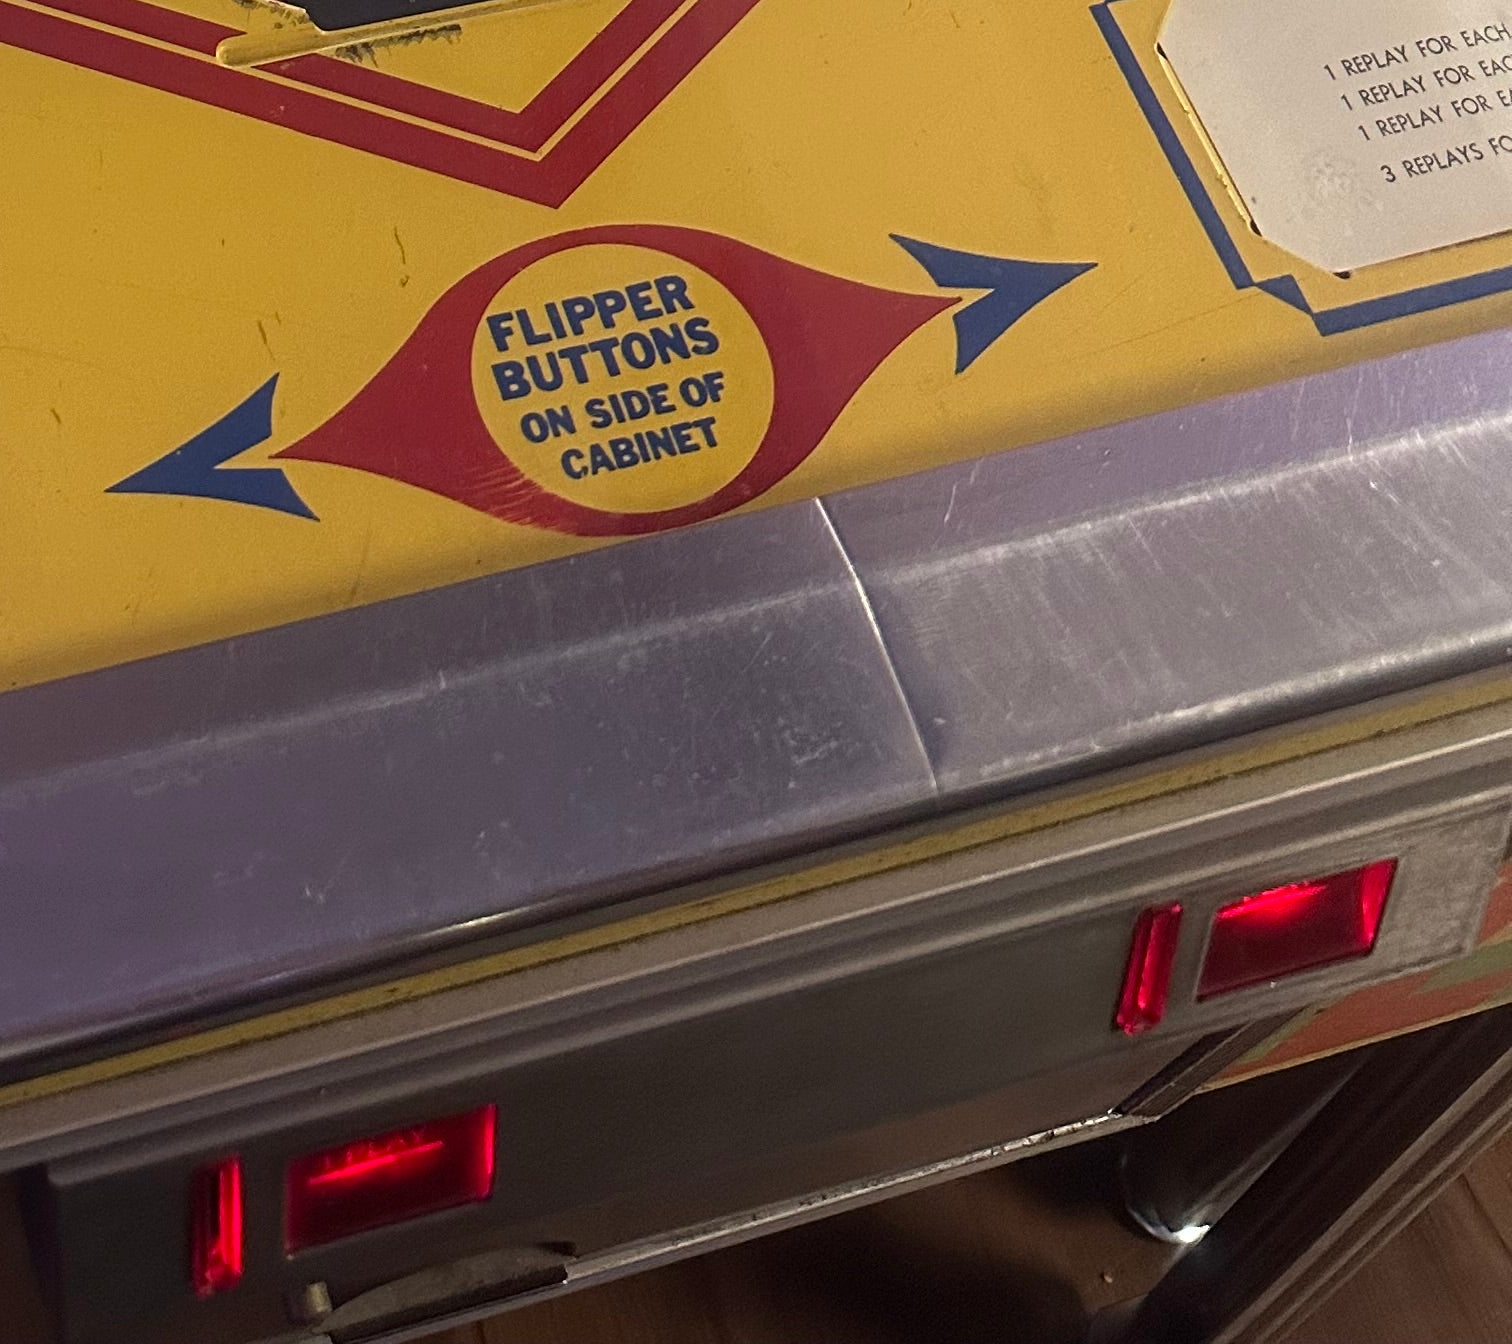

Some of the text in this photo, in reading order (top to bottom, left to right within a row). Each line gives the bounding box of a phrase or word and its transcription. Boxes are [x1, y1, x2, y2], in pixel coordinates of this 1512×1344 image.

[1323, 63, 1338, 82] 1
[1340, 43, 1410, 78] REPLAY
[1415, 33, 1458, 58] FOR
[1340, 92, 1355, 112] 1
[1357, 74, 1428, 108] REPLAY
[1432, 63, 1476, 89] FOR
[1357, 123, 1372, 143] 1
[1375, 104, 1446, 139] REPLAY
[1450, 93, 1494, 119] FOR
[1380, 163, 1398, 185] 3
[1401, 141, 1486, 179] REPLAYS
[485, 274, 696, 353] FLIPPER
[490, 316, 722, 402] BUTTONS
[519, 370, 726, 444] ON SIDE OF
[560, 416, 721, 481] CABINET
